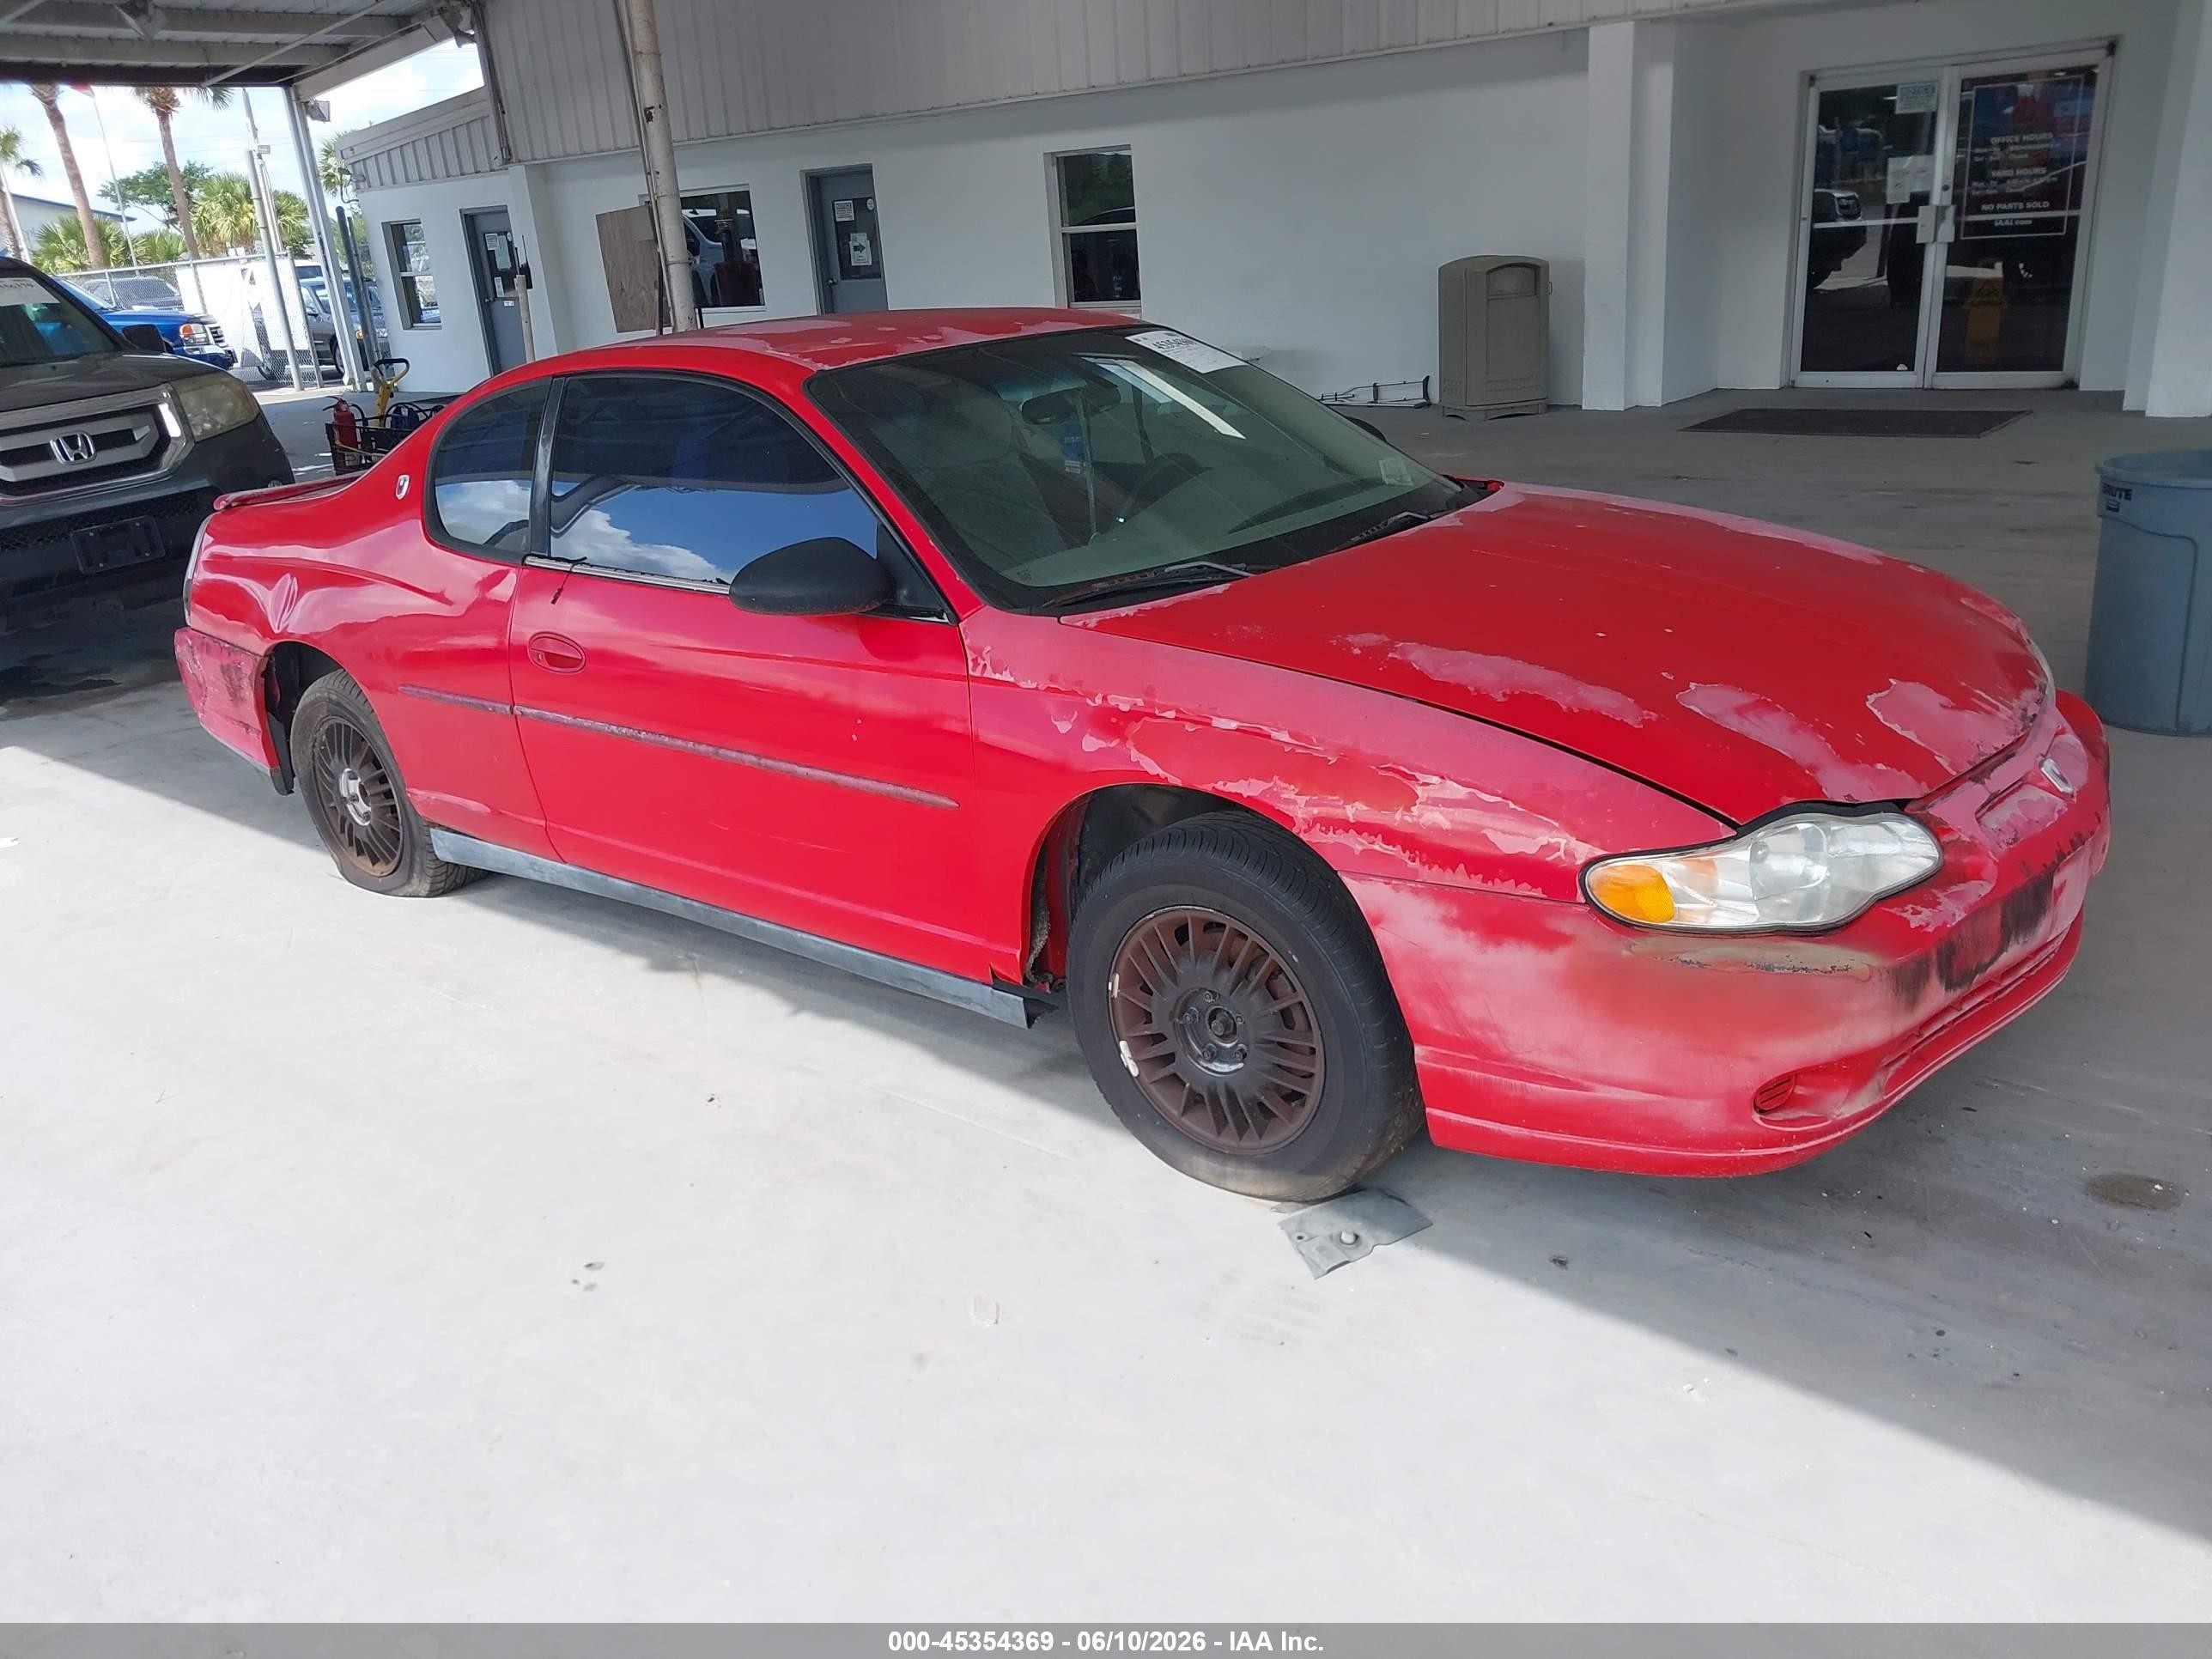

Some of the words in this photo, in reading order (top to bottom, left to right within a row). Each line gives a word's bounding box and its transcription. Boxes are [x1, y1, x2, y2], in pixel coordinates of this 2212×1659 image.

[1990, 136, 2020, 144] OFFICE
[2022, 132, 2053, 141] HOURS
[1991, 169, 2014, 178] YARD
[2015, 167, 2047, 175] HOURS
[1996, 202, 2024, 210] PARTS
